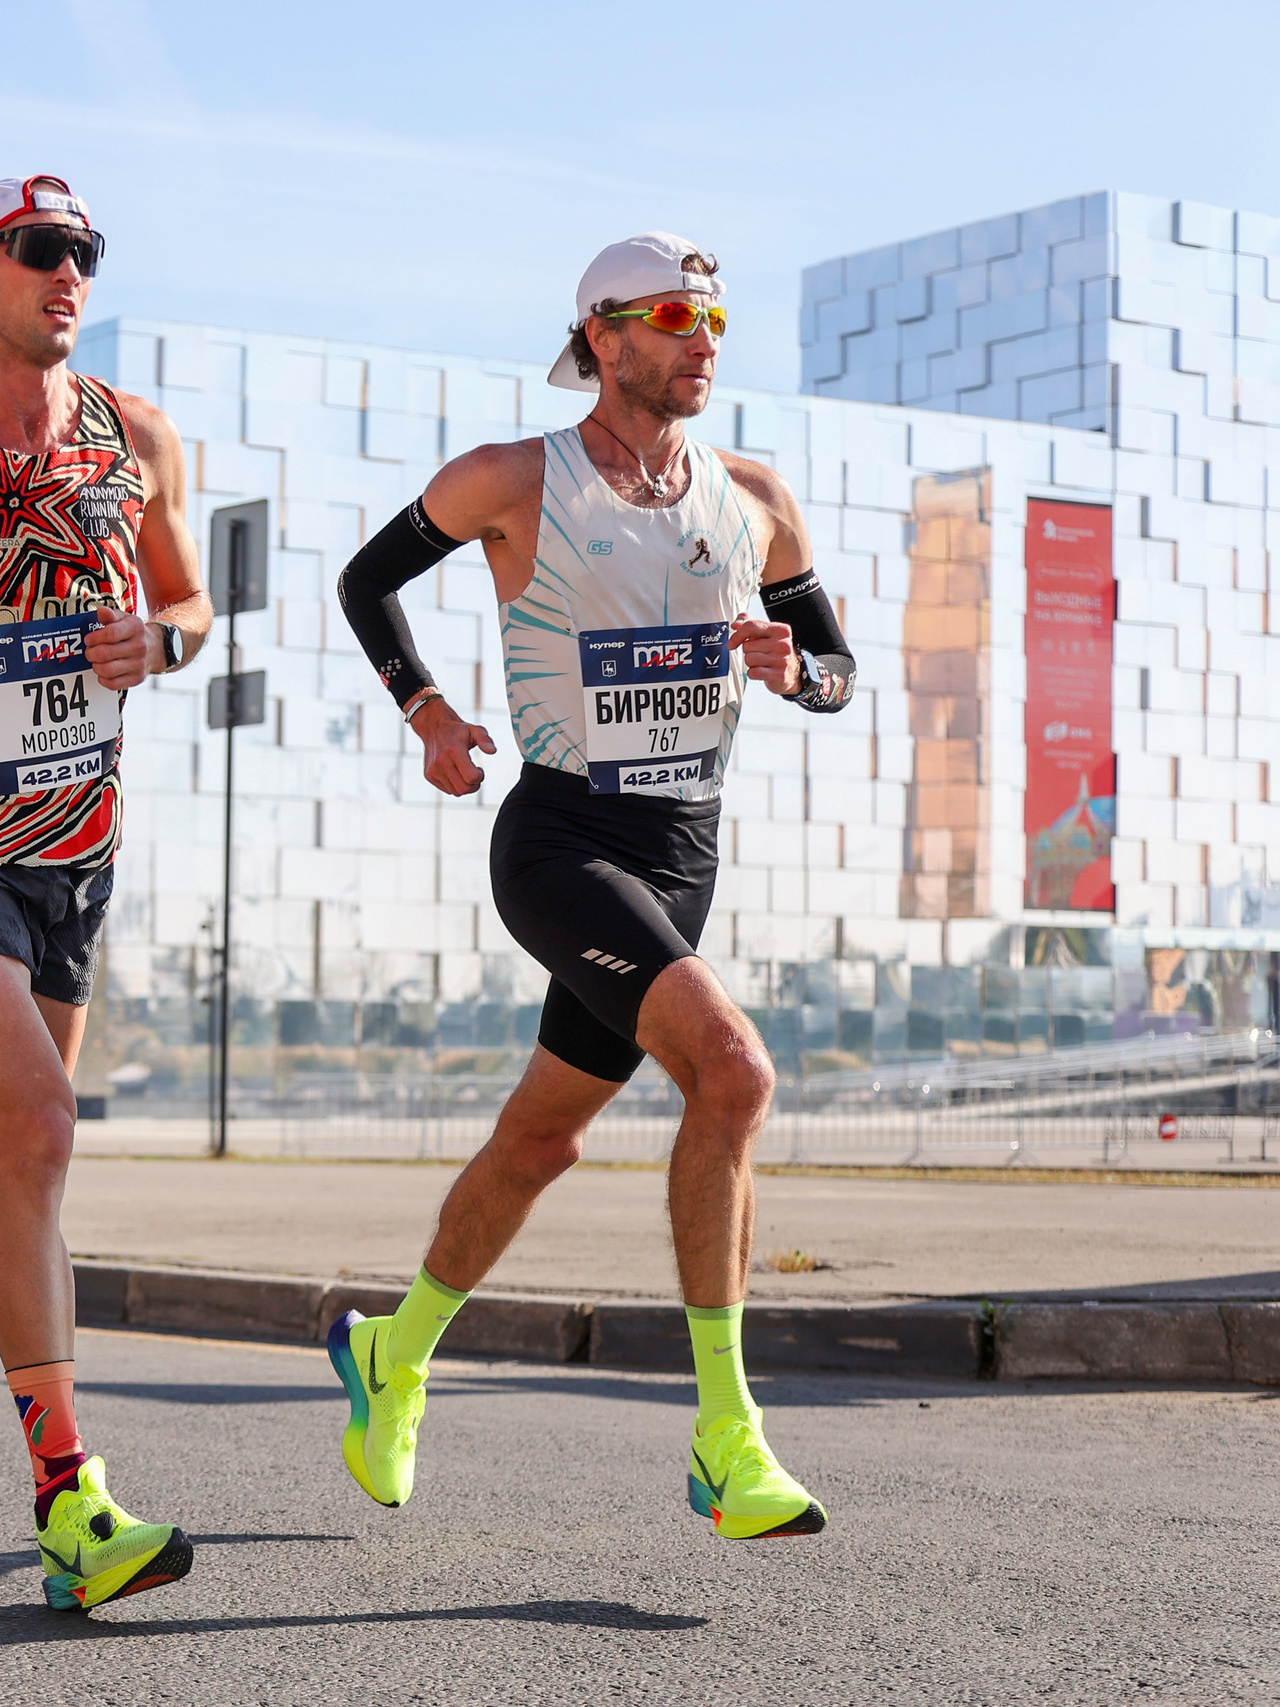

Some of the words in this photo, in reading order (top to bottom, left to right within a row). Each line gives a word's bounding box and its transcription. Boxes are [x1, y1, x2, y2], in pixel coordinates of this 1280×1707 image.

[79, 486, 129, 501] ANONYMOUS
[80, 500, 123, 520] RUNNING
[81, 519, 110, 538] CLUB
[587, 540, 613, 555] GS
[22, 674, 89, 726] 764
[595, 683, 721, 725] БИРЮЗОВ
[21, 721, 96, 754] МОРОЗОВ
[648, 727, 680, 753] 767
[22, 766, 71, 786] 42,2
[623, 769, 670, 787] 42,2
